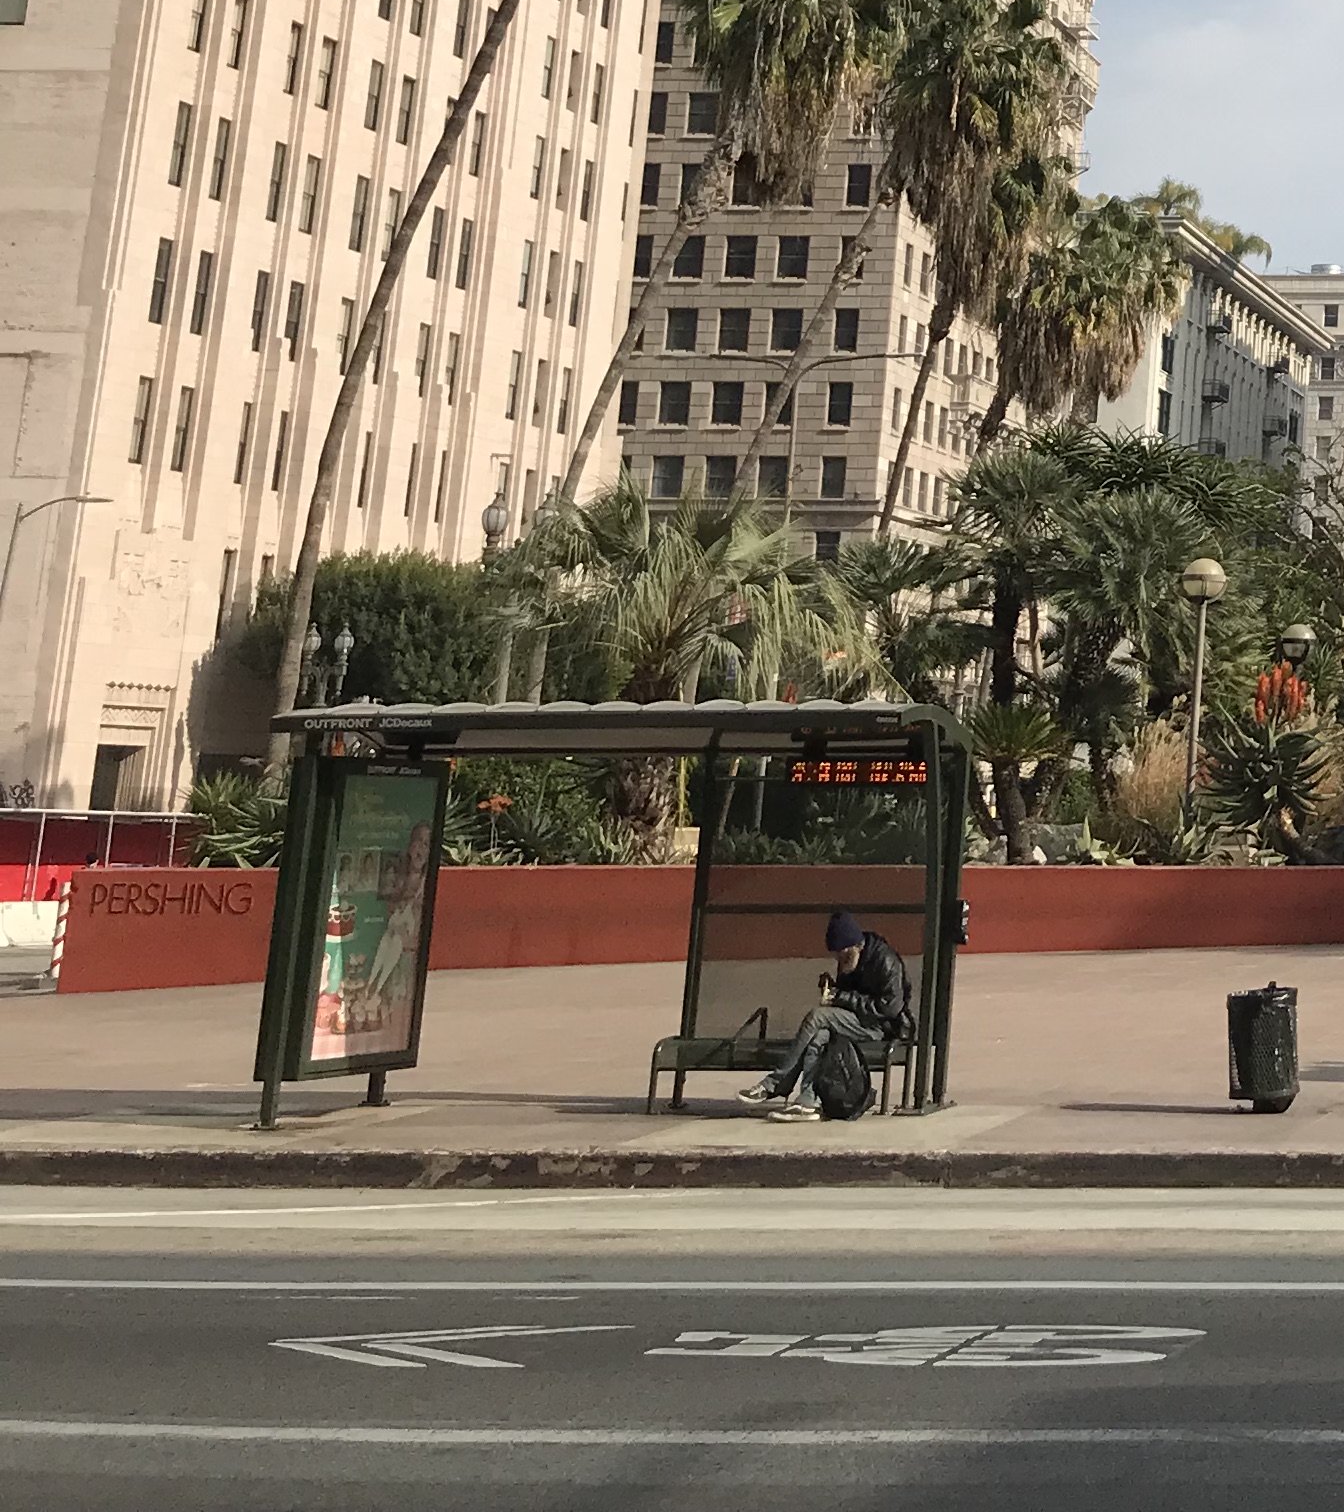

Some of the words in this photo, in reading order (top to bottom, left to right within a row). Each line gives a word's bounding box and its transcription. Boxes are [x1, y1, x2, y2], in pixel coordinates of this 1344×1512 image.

[304, 718, 373, 729] OUTFRONT
[379, 717, 433, 728] JCDecaux
[89, 882, 252, 917] PERSHING
